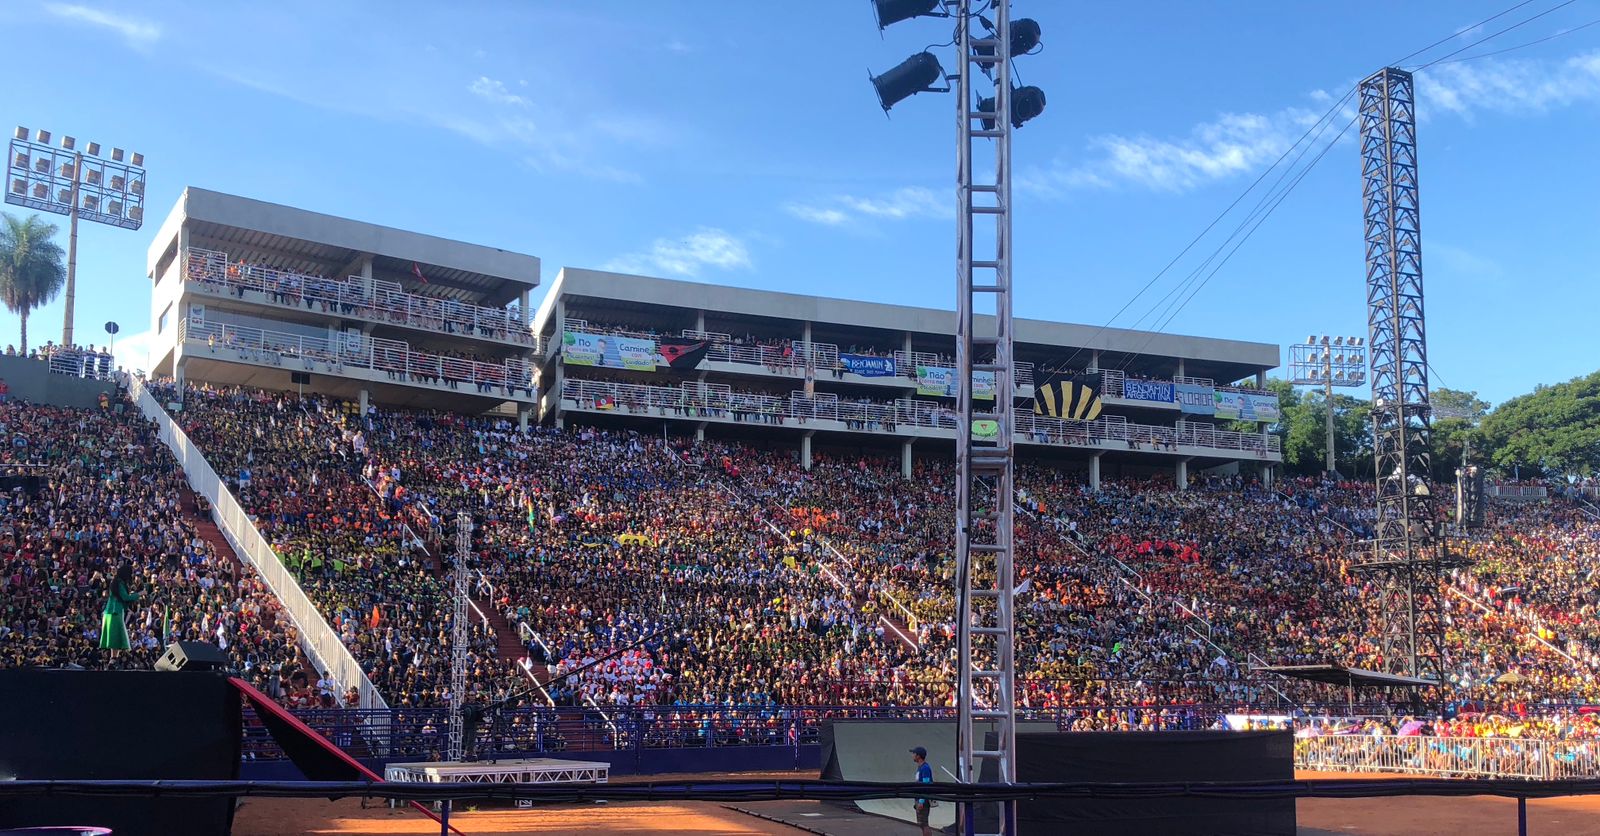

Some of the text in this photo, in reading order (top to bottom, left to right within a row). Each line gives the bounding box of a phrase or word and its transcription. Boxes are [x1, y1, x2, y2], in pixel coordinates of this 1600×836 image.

[620, 344, 650, 354] Camine
[852, 360, 884, 369] BENJAMIN
[1126, 383, 1170, 394] BENJAMIN
[1126, 390, 1171, 401] ARGENTINA
